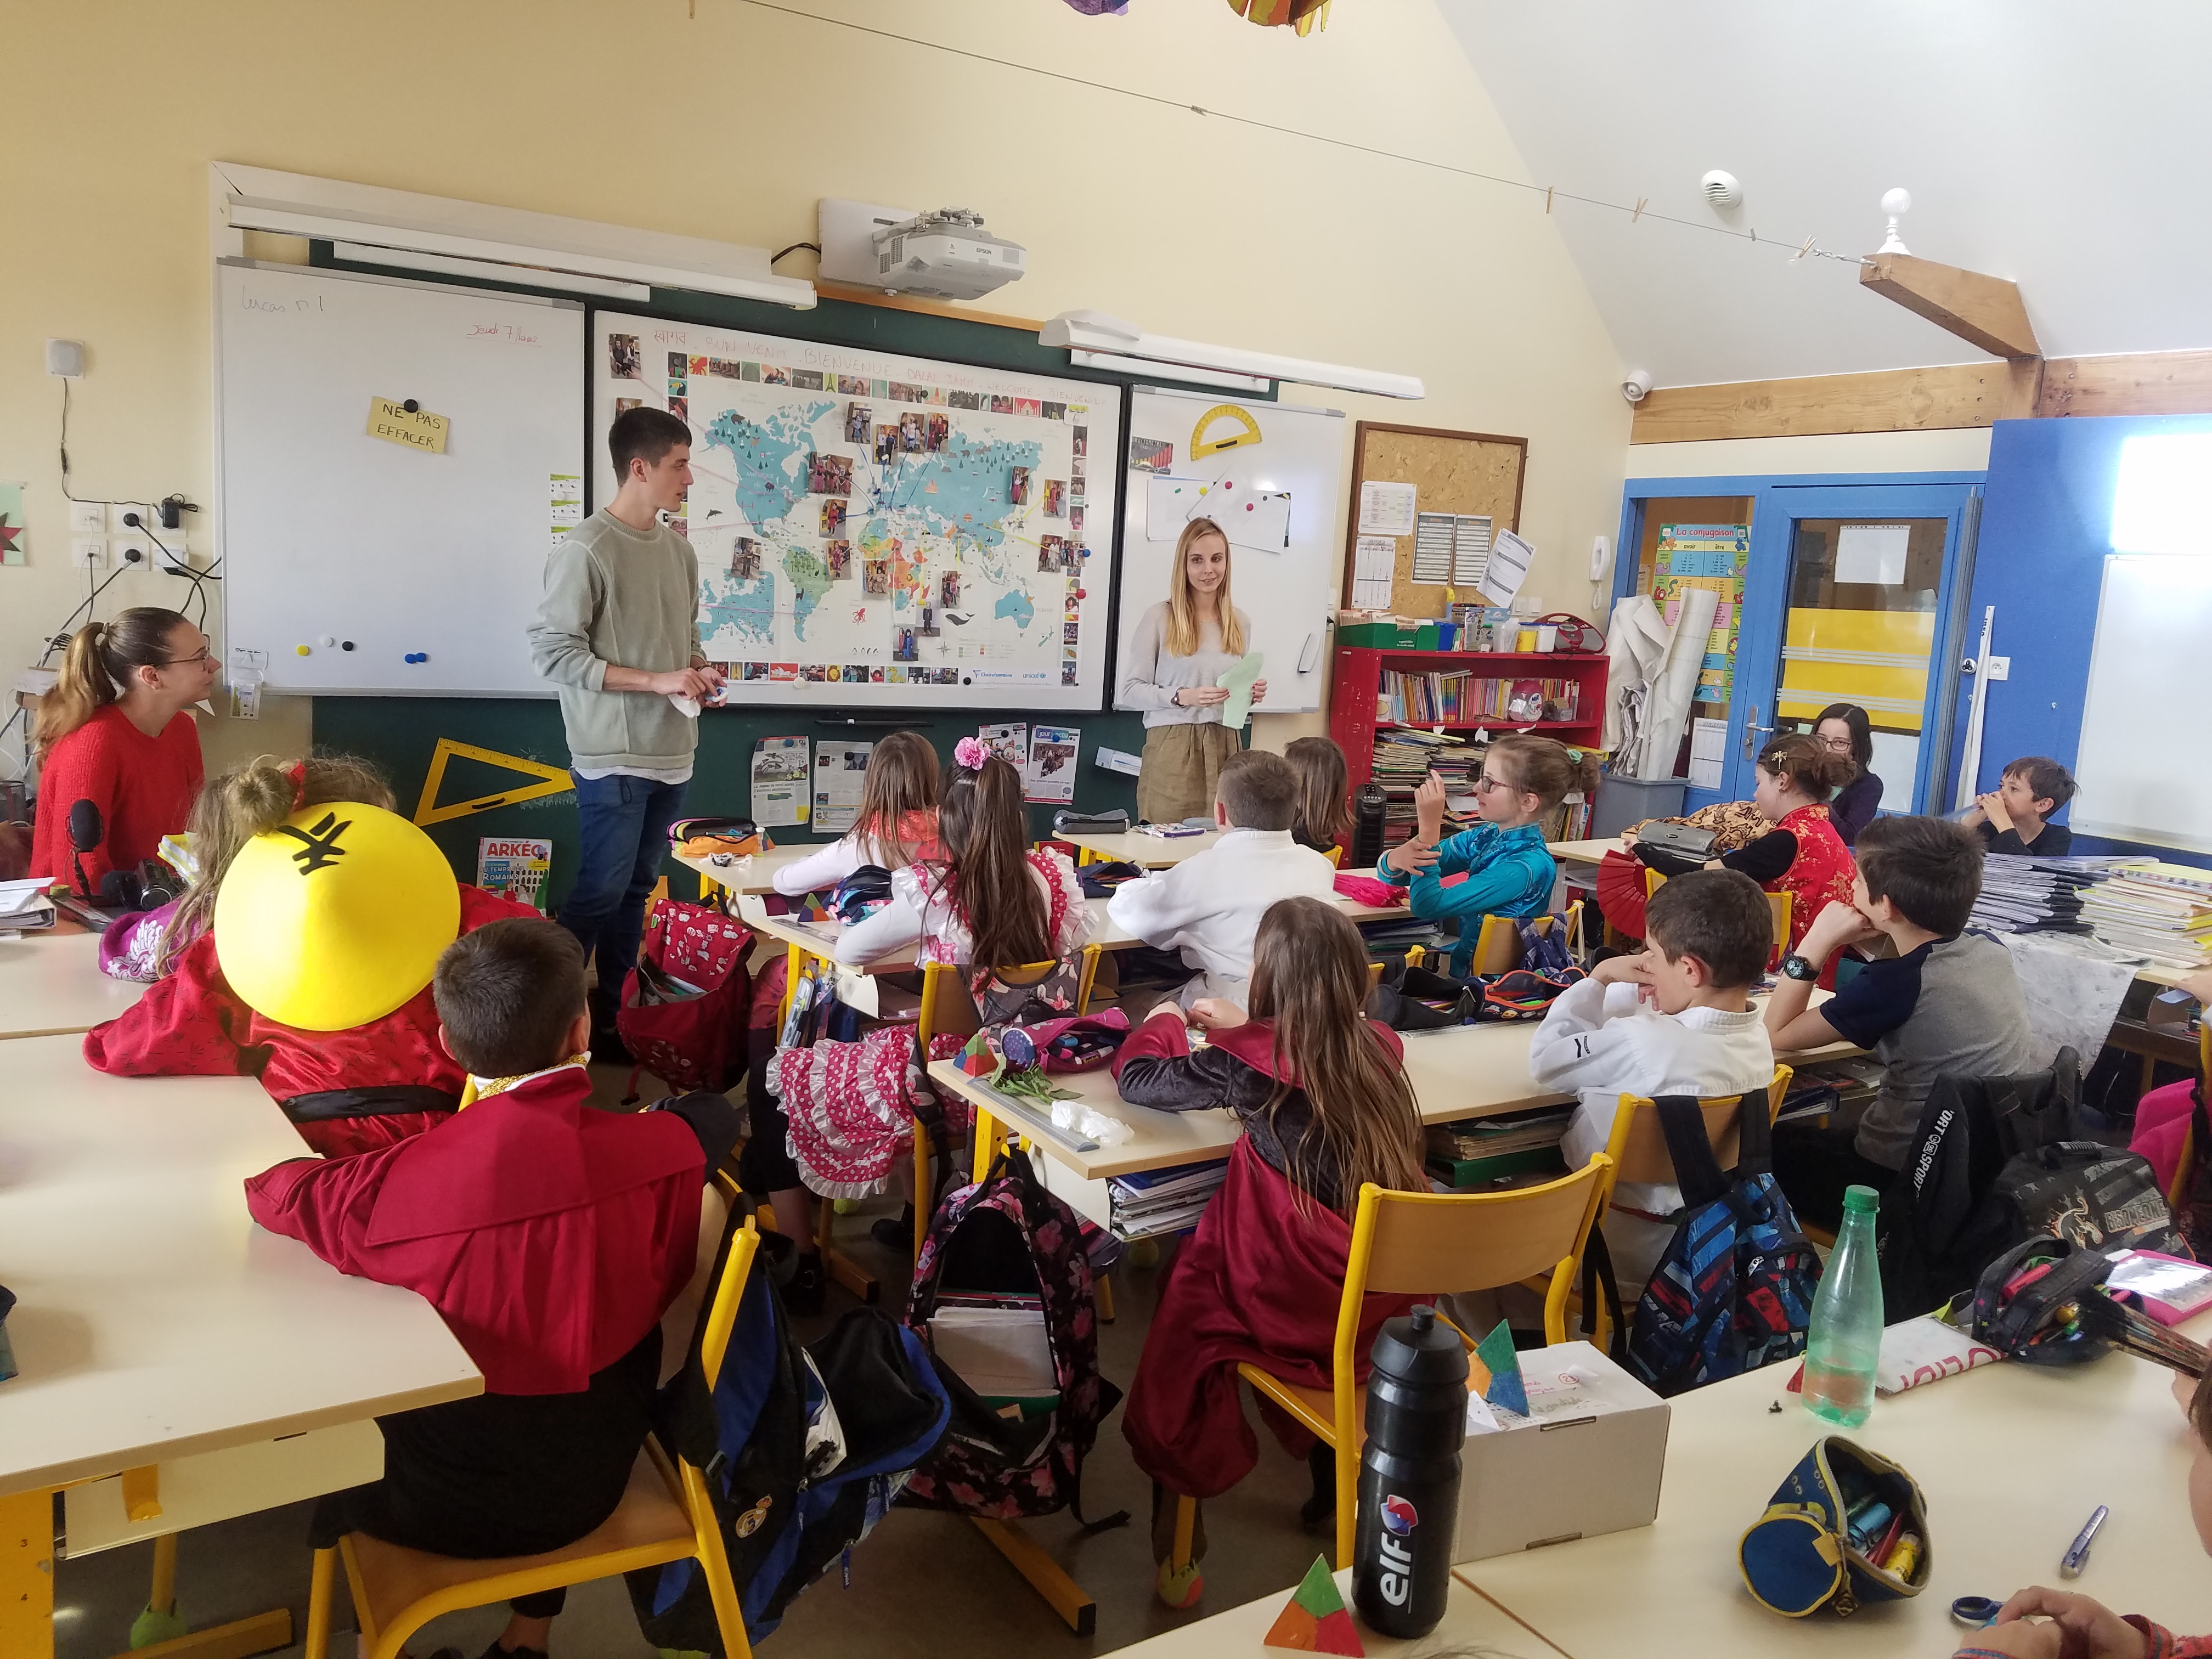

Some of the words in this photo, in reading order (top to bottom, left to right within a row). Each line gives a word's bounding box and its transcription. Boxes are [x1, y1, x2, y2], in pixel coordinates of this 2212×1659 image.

[466, 322, 500, 336] Jeudi
[502, 325, 512, 339] 7
[706, 336, 736, 353] BUN
[747, 341, 789, 361] VENIT
[804, 347, 893, 376] BIENVENUE
[907, 368, 940, 383] DALAL
[987, 381, 1034, 396] WELCOME
[1048, 387, 1108, 405] BIENVENIDA
[382, 403, 405, 419] NE
[416, 411, 441, 429] PAS
[377, 424, 434, 449] EFFACER
[1689, 528, 1735, 539] conjugaison
[1934, 1109, 1956, 1136] ORT
[1913, 1153, 1933, 1192] SPORT
